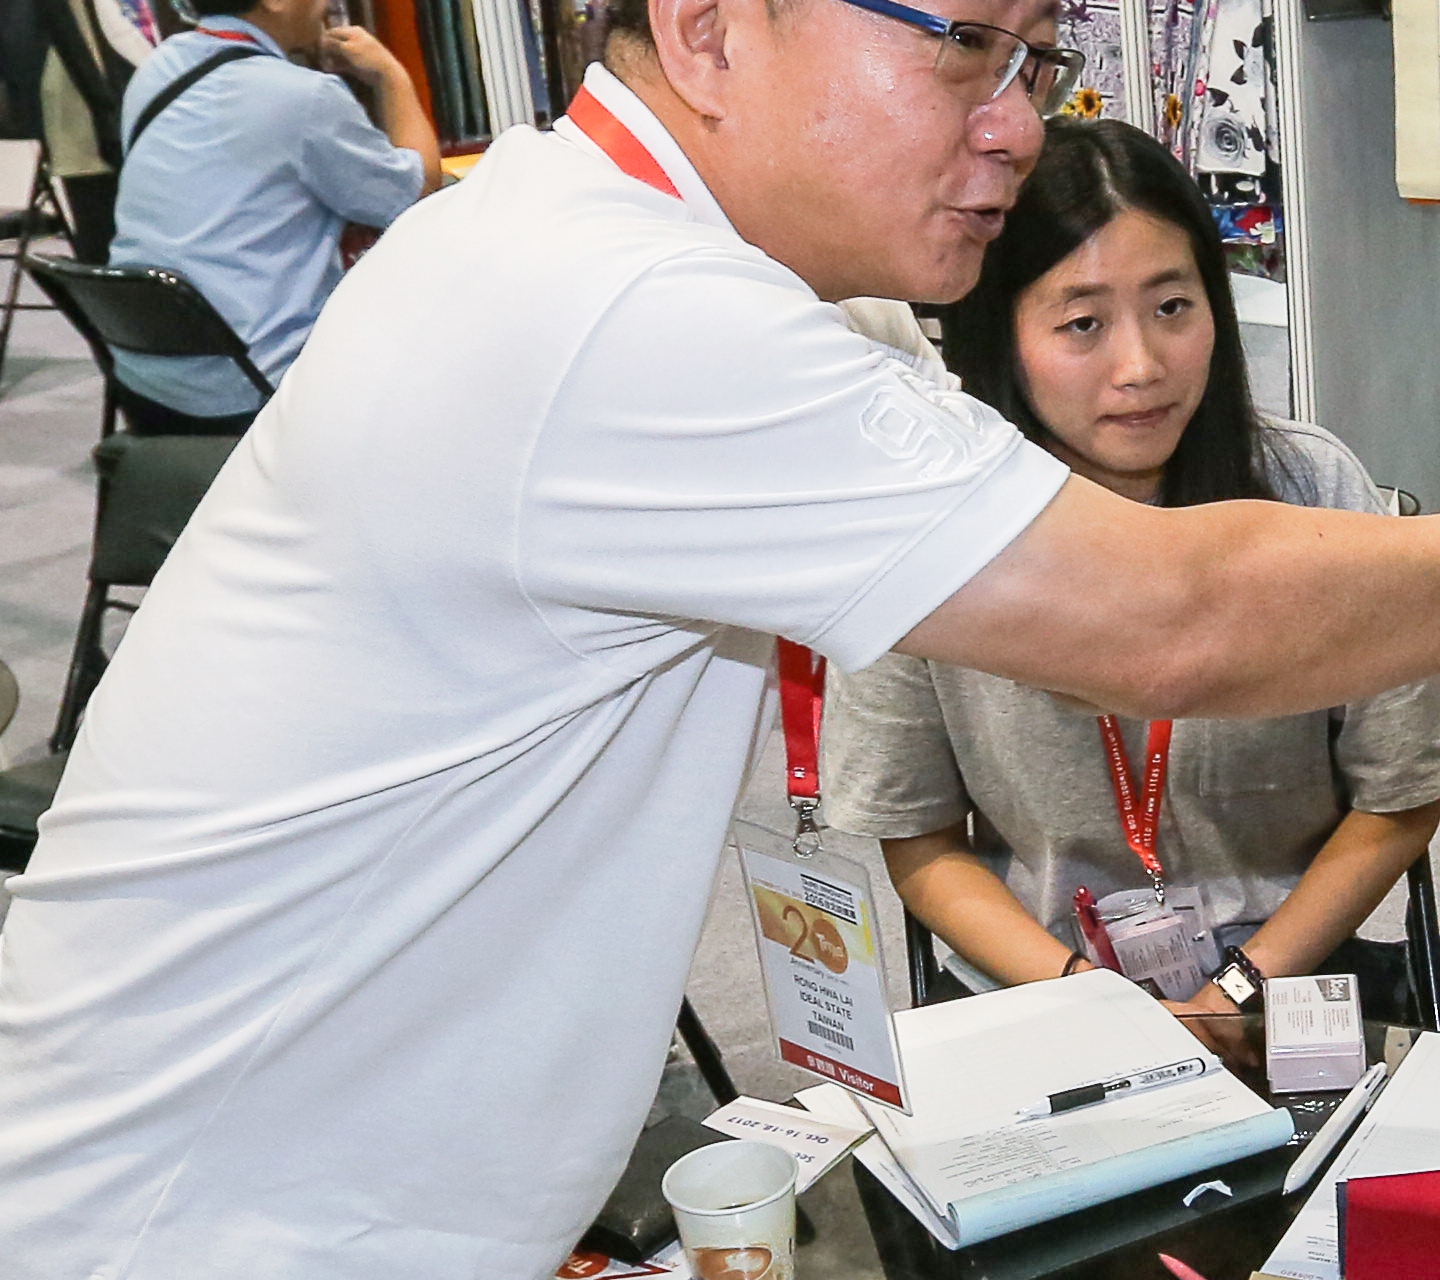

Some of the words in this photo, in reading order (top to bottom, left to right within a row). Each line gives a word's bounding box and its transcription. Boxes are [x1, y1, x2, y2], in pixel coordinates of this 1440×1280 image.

[799, 989, 823, 1011] IDEAL
[824, 1000, 853, 1020] STATE
[812, 1010, 845, 1032] TAIWAN
[839, 1066, 875, 1092] Visitor
[726, 1116, 761, 1128] 2017
